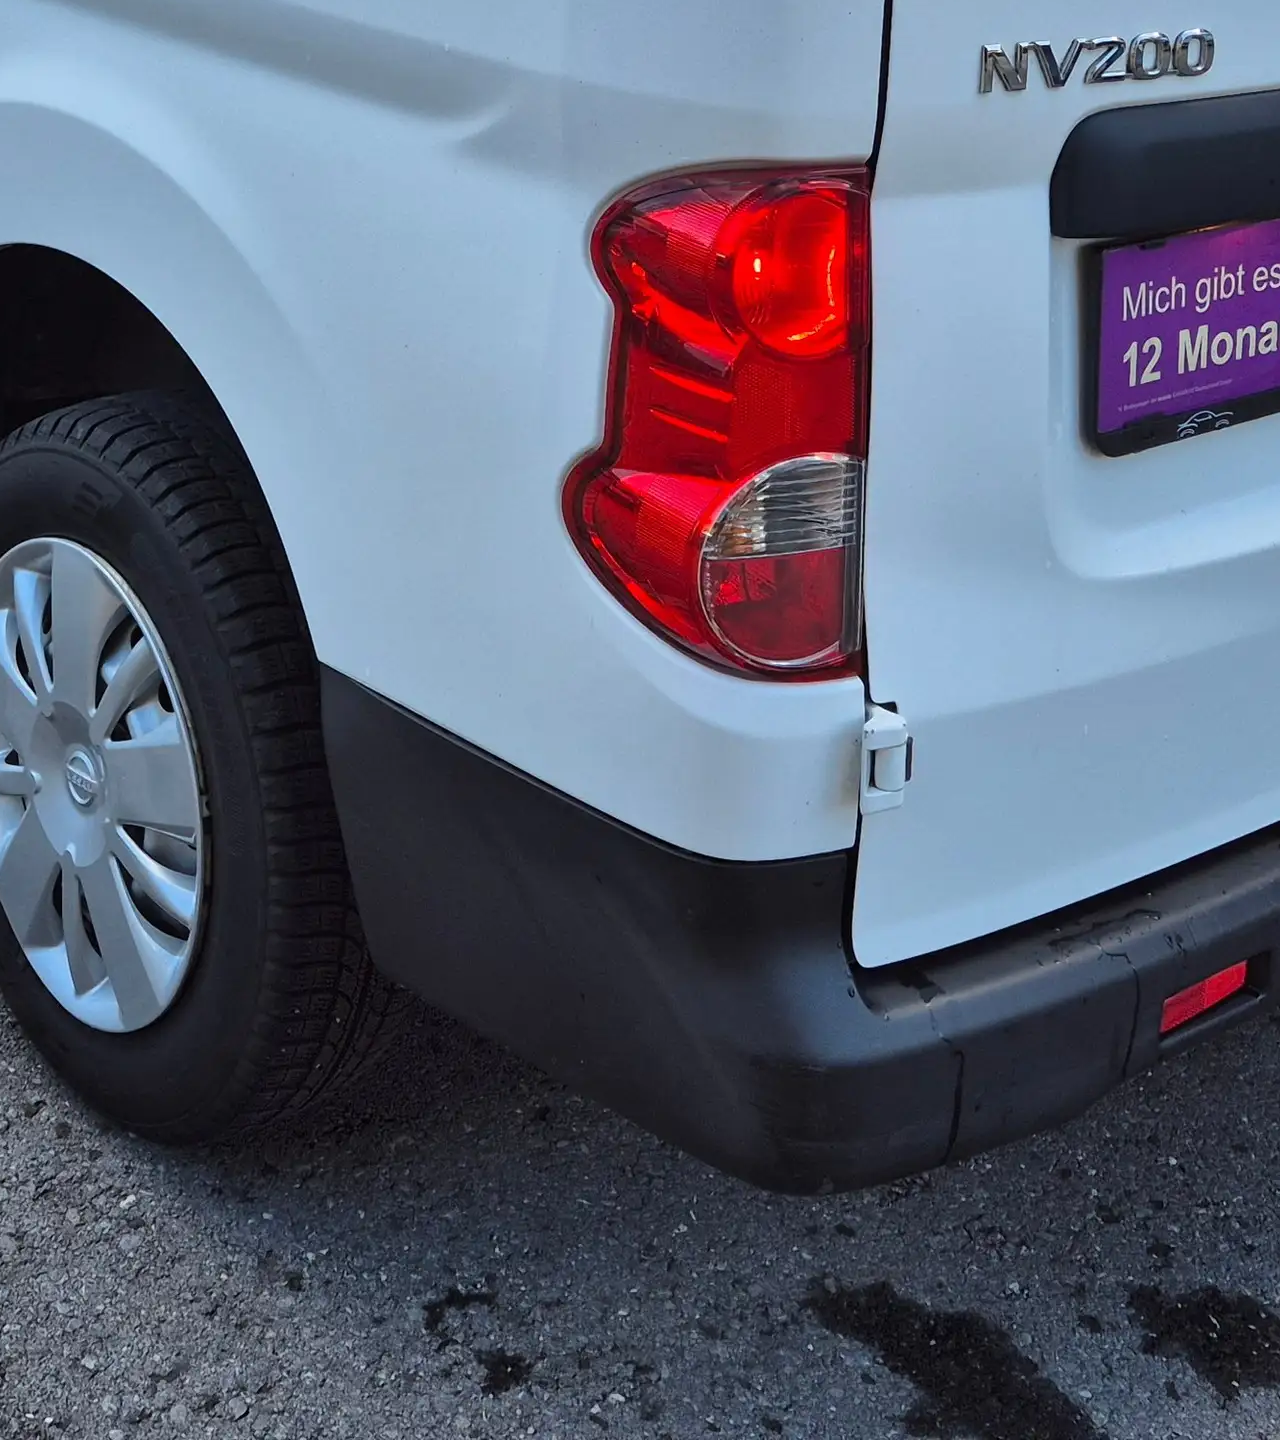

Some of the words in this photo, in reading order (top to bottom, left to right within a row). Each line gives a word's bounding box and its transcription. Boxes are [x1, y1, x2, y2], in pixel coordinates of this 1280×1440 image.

[979, 27, 1216, 94] NV200
[1122, 275, 1187, 321] Mich
[1194, 263, 1245, 313] gibt
[1122, 336, 1162, 388] 12
